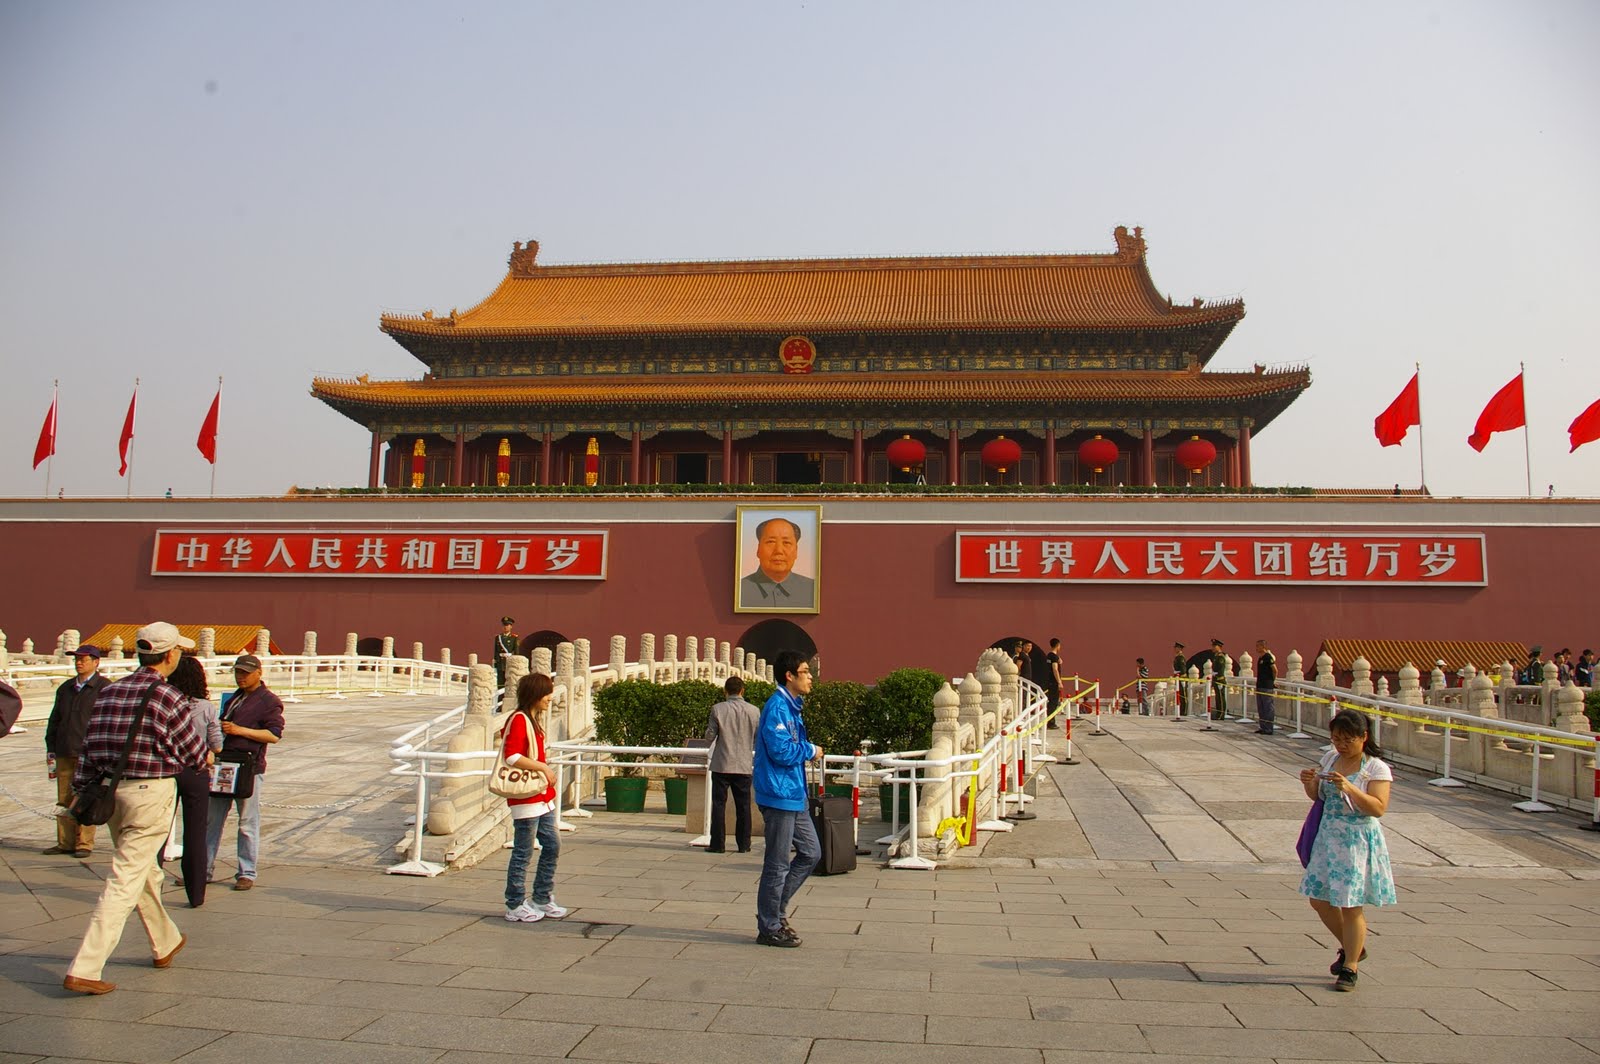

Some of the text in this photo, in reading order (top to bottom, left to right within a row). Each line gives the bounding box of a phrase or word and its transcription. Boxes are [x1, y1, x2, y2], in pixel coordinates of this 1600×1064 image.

[175, 537, 581, 571] 中华人民共和国万岁
[985, 540, 1458, 578] 世界人民大团结万岁
